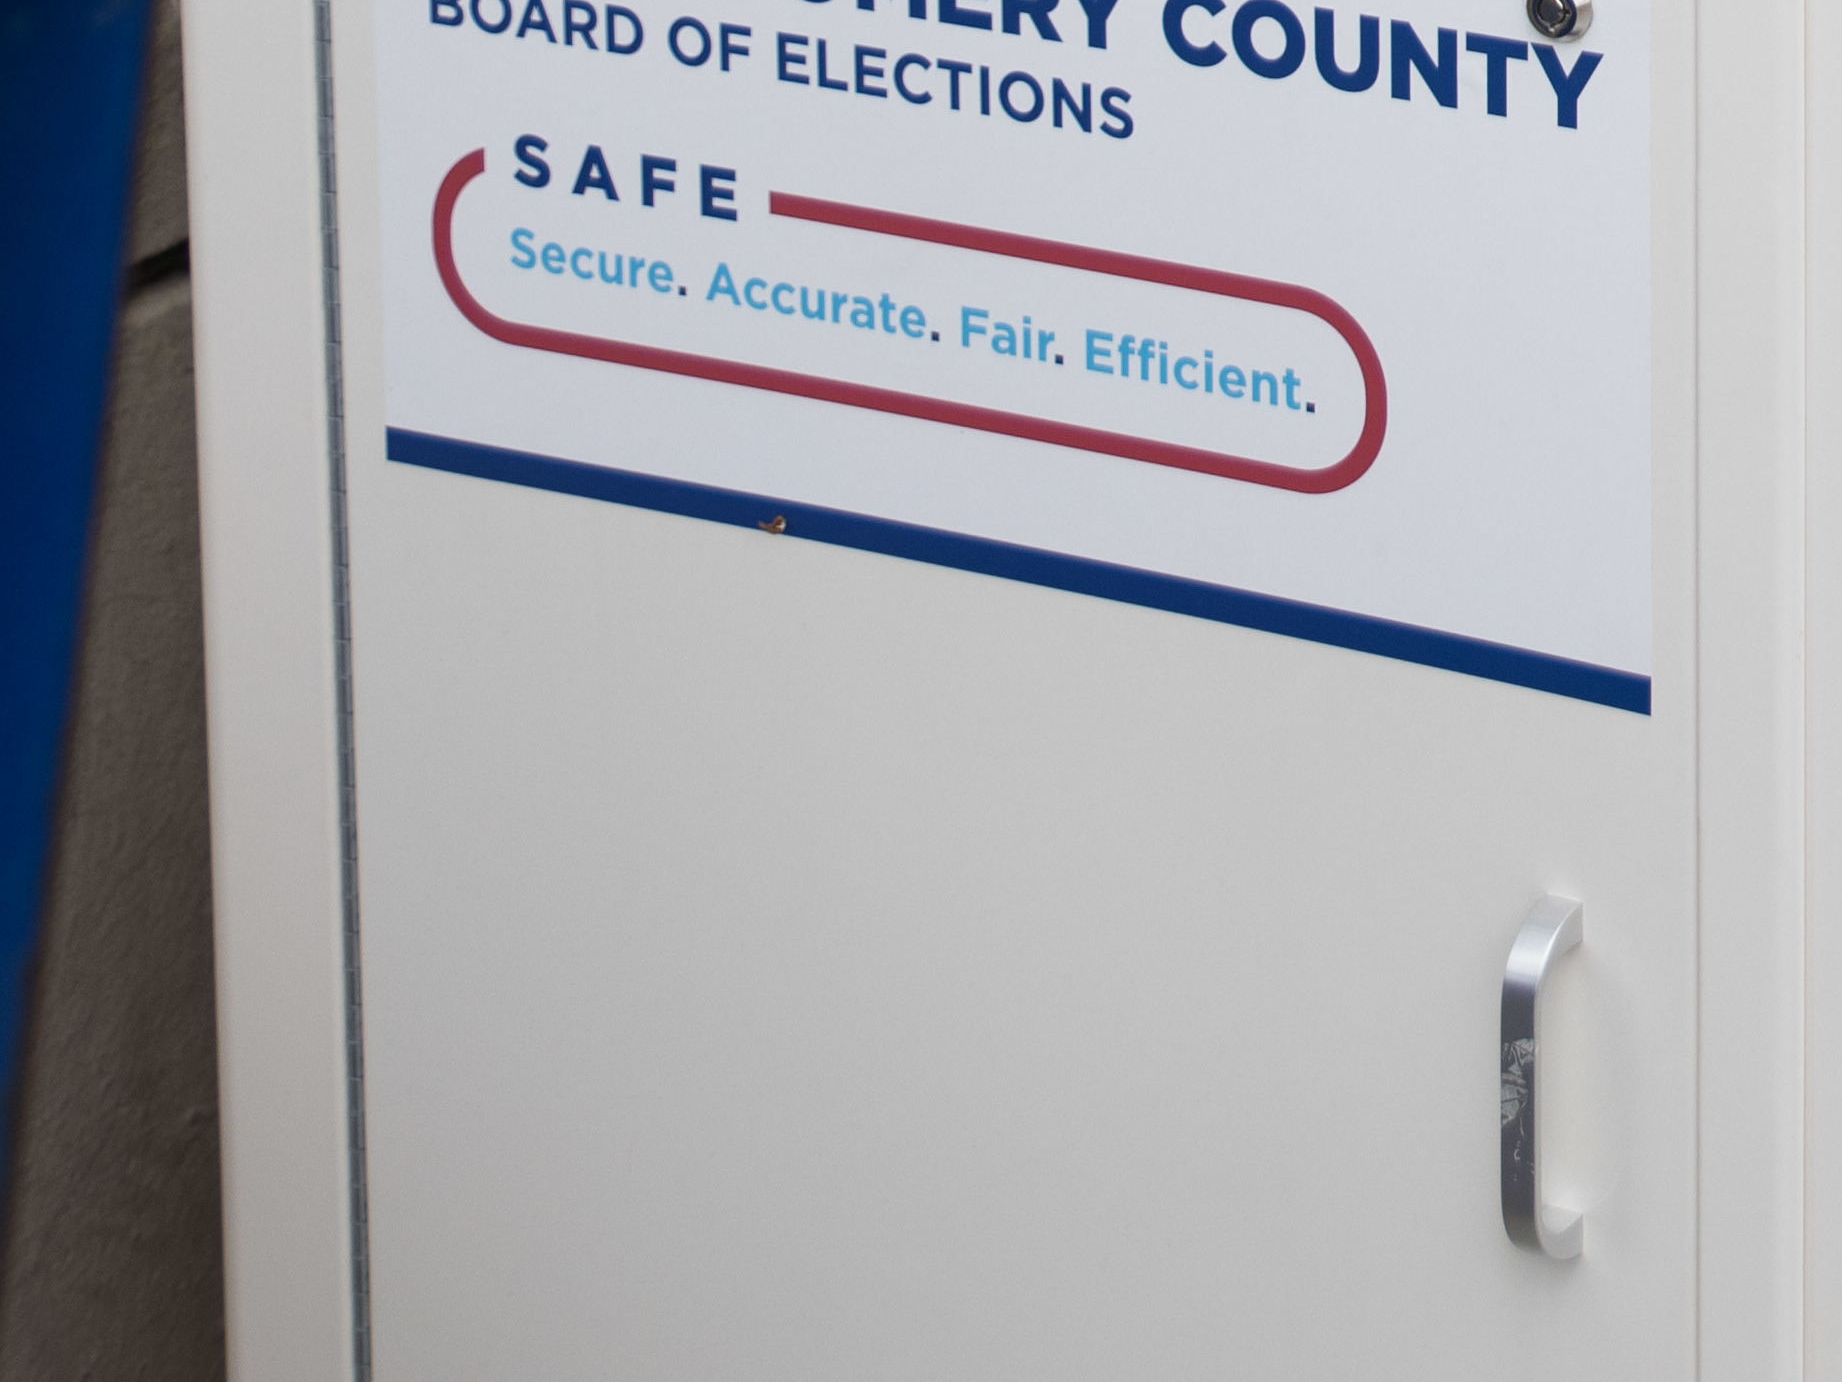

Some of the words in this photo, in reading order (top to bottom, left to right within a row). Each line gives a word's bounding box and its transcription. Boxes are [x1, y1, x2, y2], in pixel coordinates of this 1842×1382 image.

[666, 16, 753, 73] OF
[775, 31, 1135, 141] ELECTIONS
[513, 133, 739, 223] SAFE
[509, 227, 688, 298] Secure.
[705, 262, 941, 344] Accurate.
[960, 306, 1065, 367] Fair.
[1084, 329, 1317, 415] Efficient.
